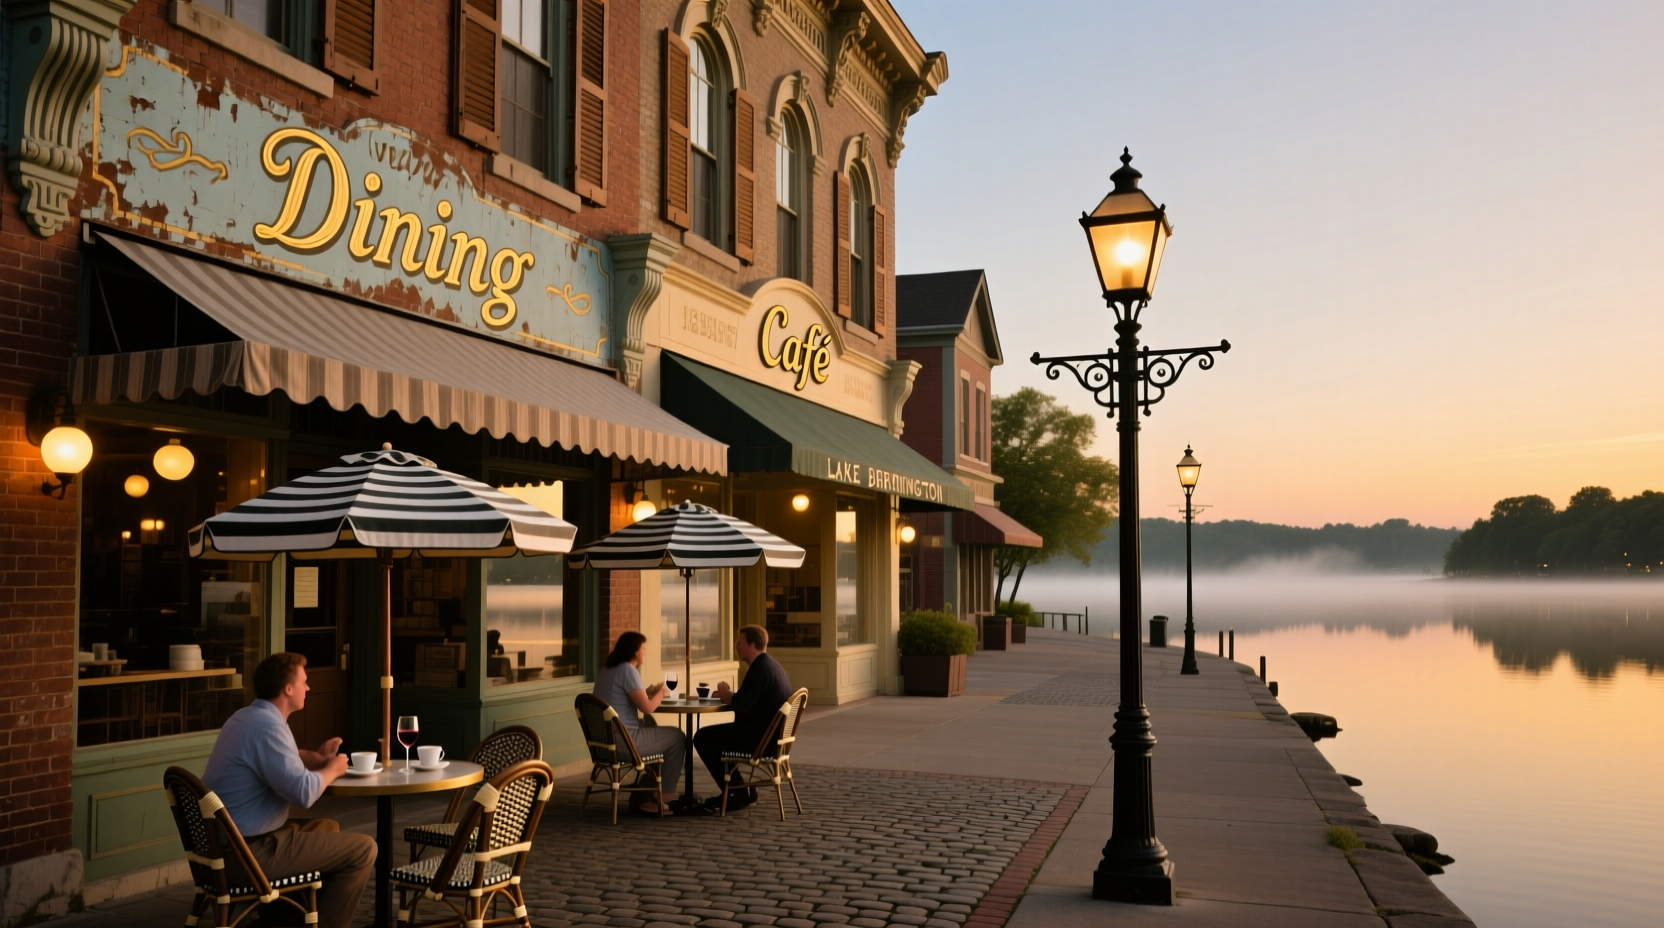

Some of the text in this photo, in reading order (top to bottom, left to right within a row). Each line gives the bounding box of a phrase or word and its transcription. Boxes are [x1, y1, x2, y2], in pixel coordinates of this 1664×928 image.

[254, 127, 535, 329] Dining
[758, 305, 832, 391] Café
[827, 457, 861, 484] LAKE
